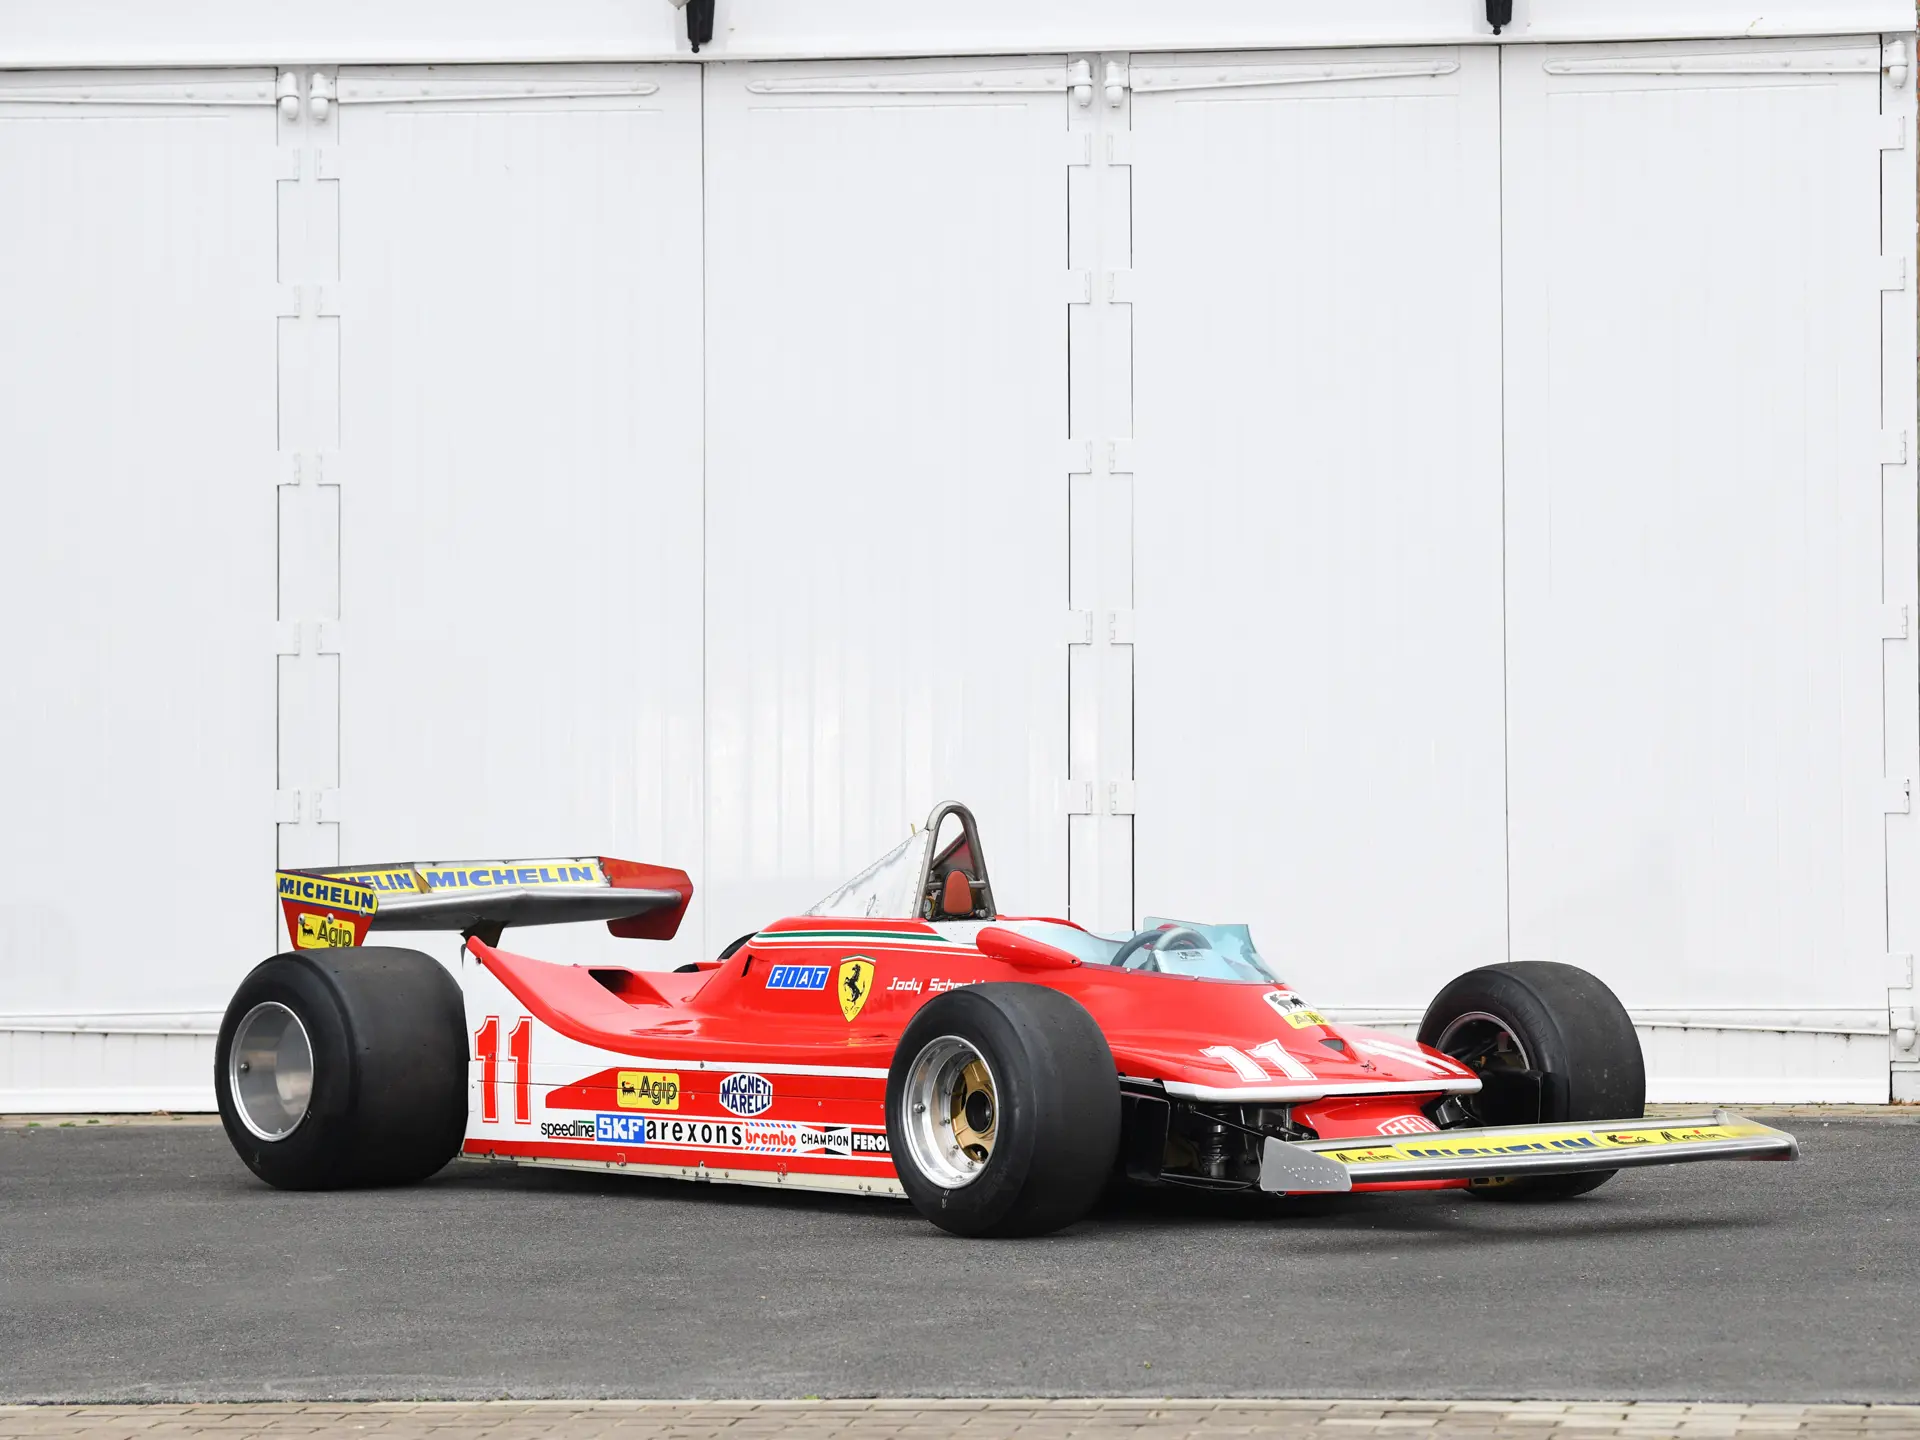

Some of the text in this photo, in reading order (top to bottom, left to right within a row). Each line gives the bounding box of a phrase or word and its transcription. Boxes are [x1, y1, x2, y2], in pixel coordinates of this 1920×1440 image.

[426, 866, 594, 888] MICHELIN
[279, 877, 374, 909] MICHELIN
[316, 920, 352, 948] Agip
[772, 966, 827, 986] FIAT
[886, 977, 922, 994] Jody
[474, 1015, 533, 1125] 11
[1198, 1039, 1319, 1083] 11
[638, 1075, 678, 1106] Agip
[721, 1074, 771, 1095] MAGNETI
[721, 1094, 771, 1114] MARELLI
[540, 1120, 595, 1140] speedline
[598, 1117, 644, 1141] SKF
[646, 1120, 742, 1146] arexons
[745, 1130, 797, 1147] brembo
[801, 1132, 849, 1147] CHAMPION
